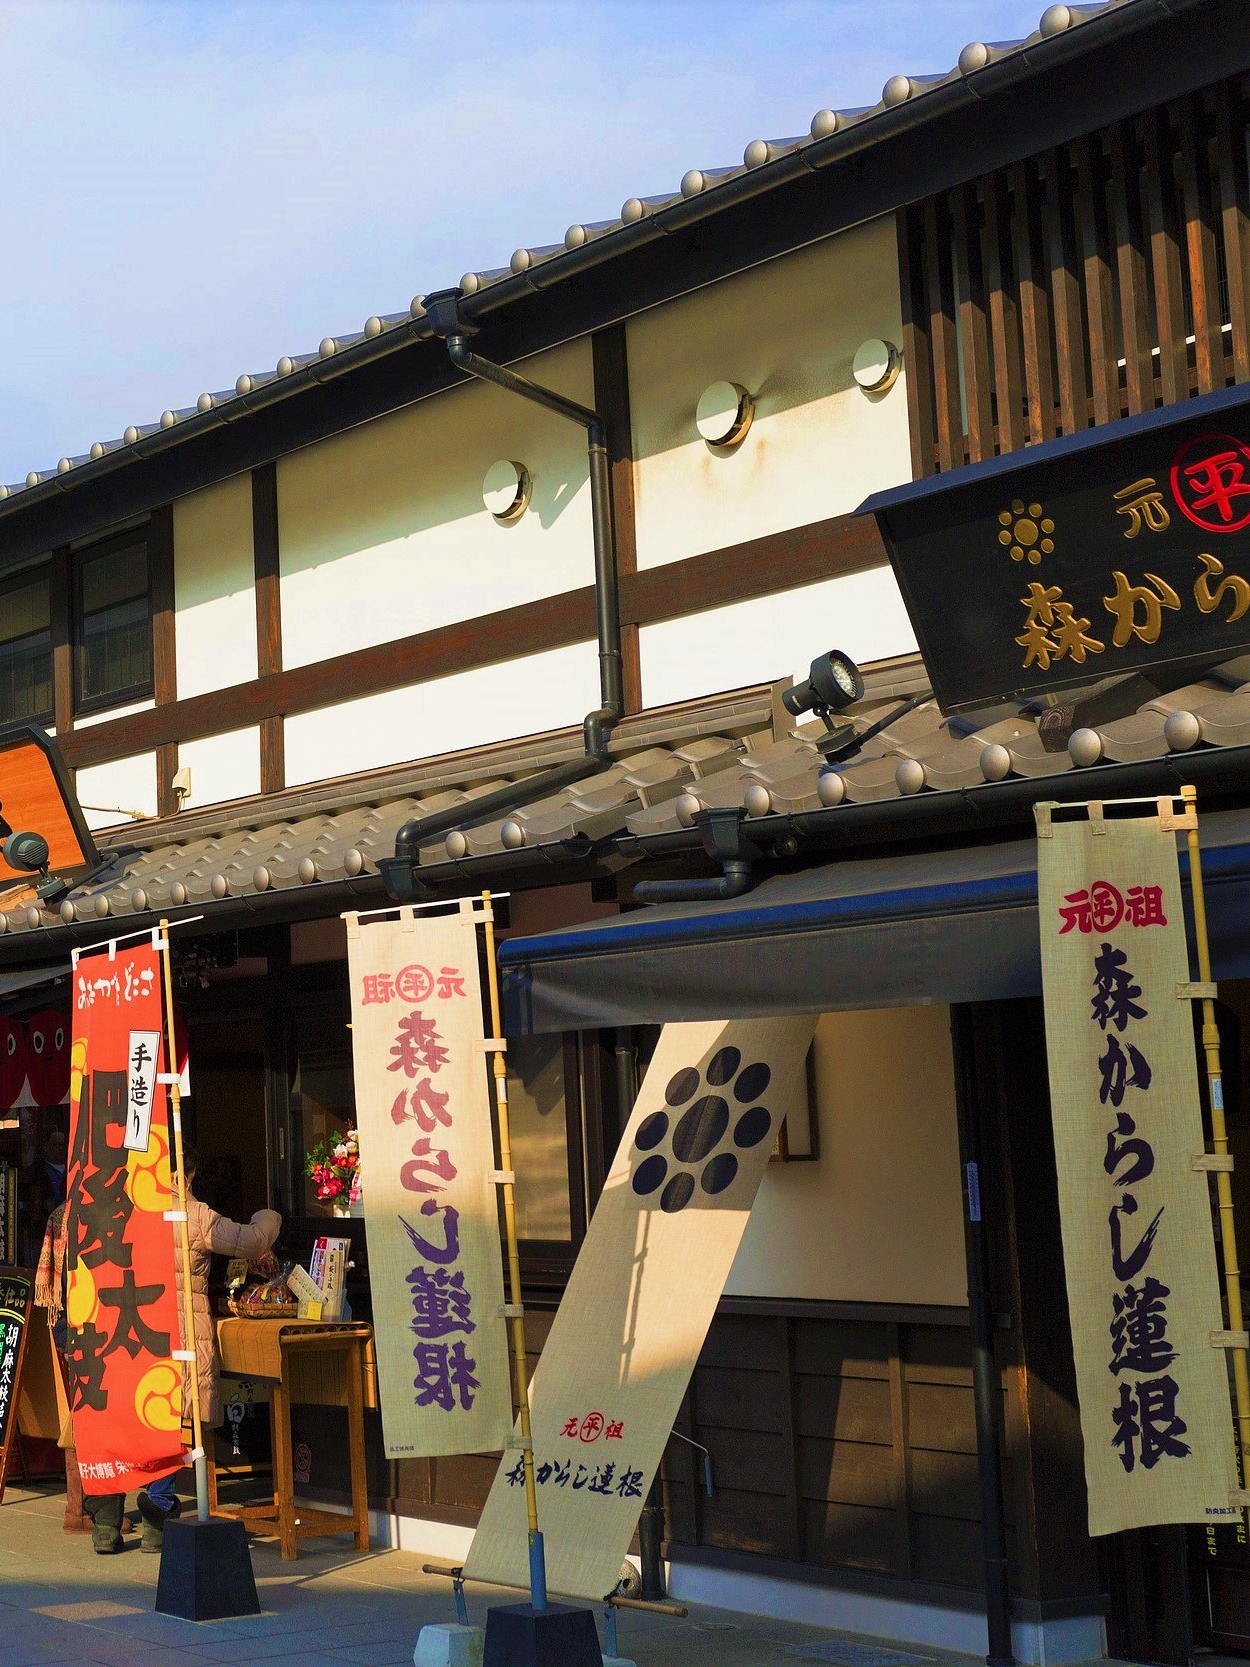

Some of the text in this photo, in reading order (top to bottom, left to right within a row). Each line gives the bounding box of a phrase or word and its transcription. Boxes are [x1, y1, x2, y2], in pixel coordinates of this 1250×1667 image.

[67, 1070, 171, 1413] 肥後太鼓
[130, 1043, 152, 1139] 手造り
[1090, 942, 1193, 1473] 森からし蓮根
